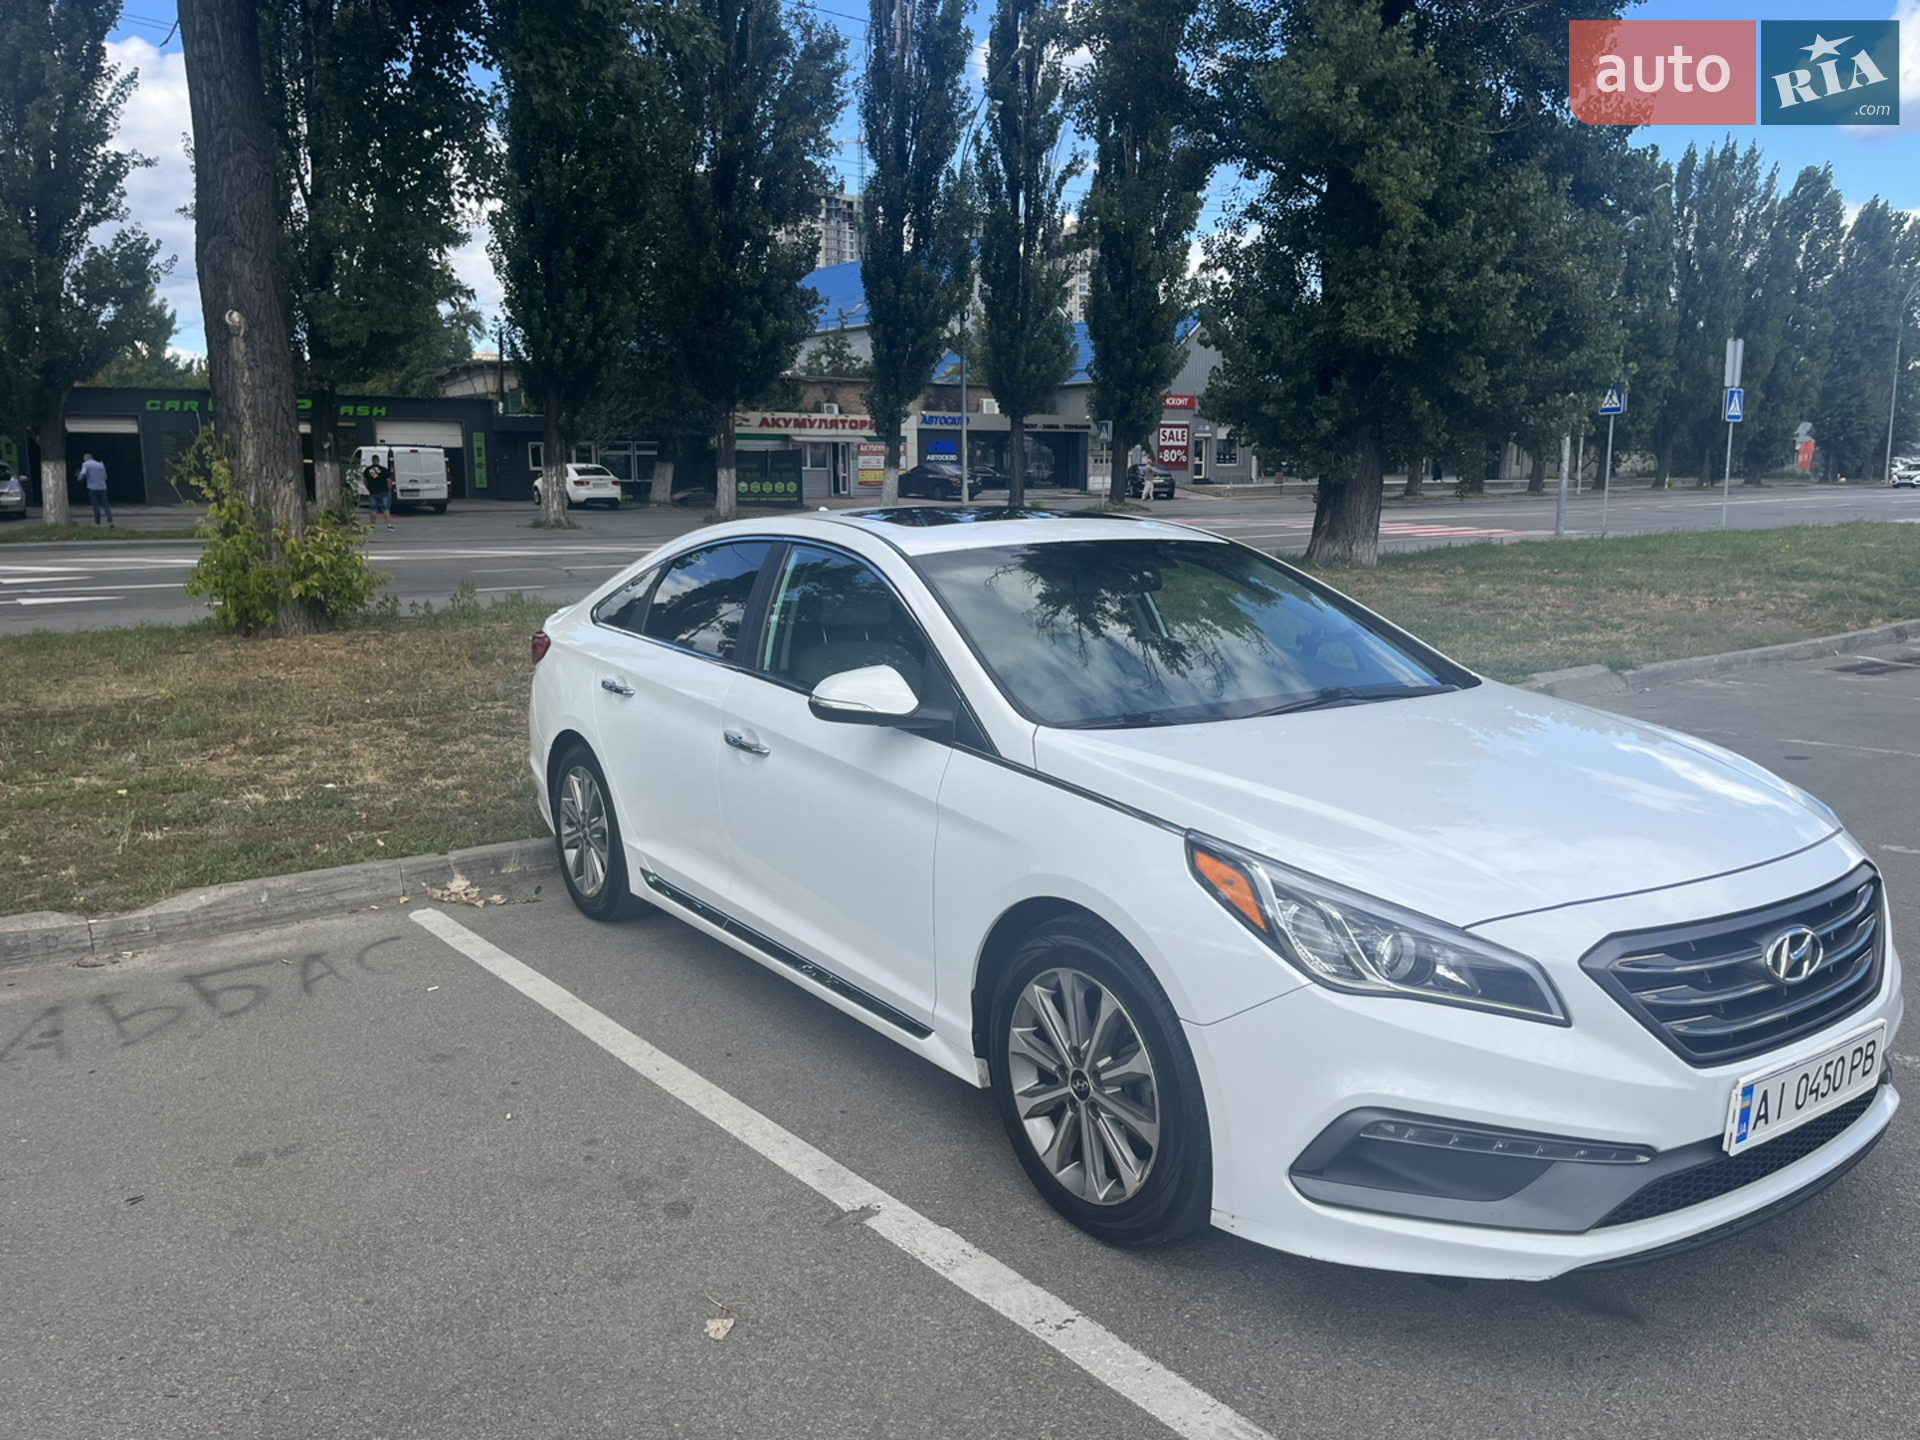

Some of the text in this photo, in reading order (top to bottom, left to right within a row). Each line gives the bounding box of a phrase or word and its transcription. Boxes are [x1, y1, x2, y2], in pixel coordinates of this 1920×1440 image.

[146, 399, 199, 412] CAR
[759, 417, 877, 430] АКУМУЛЯТОРИ
[1161, 429, 1186, 442] SALE
[1752, 1082, 1785, 1131] AI
